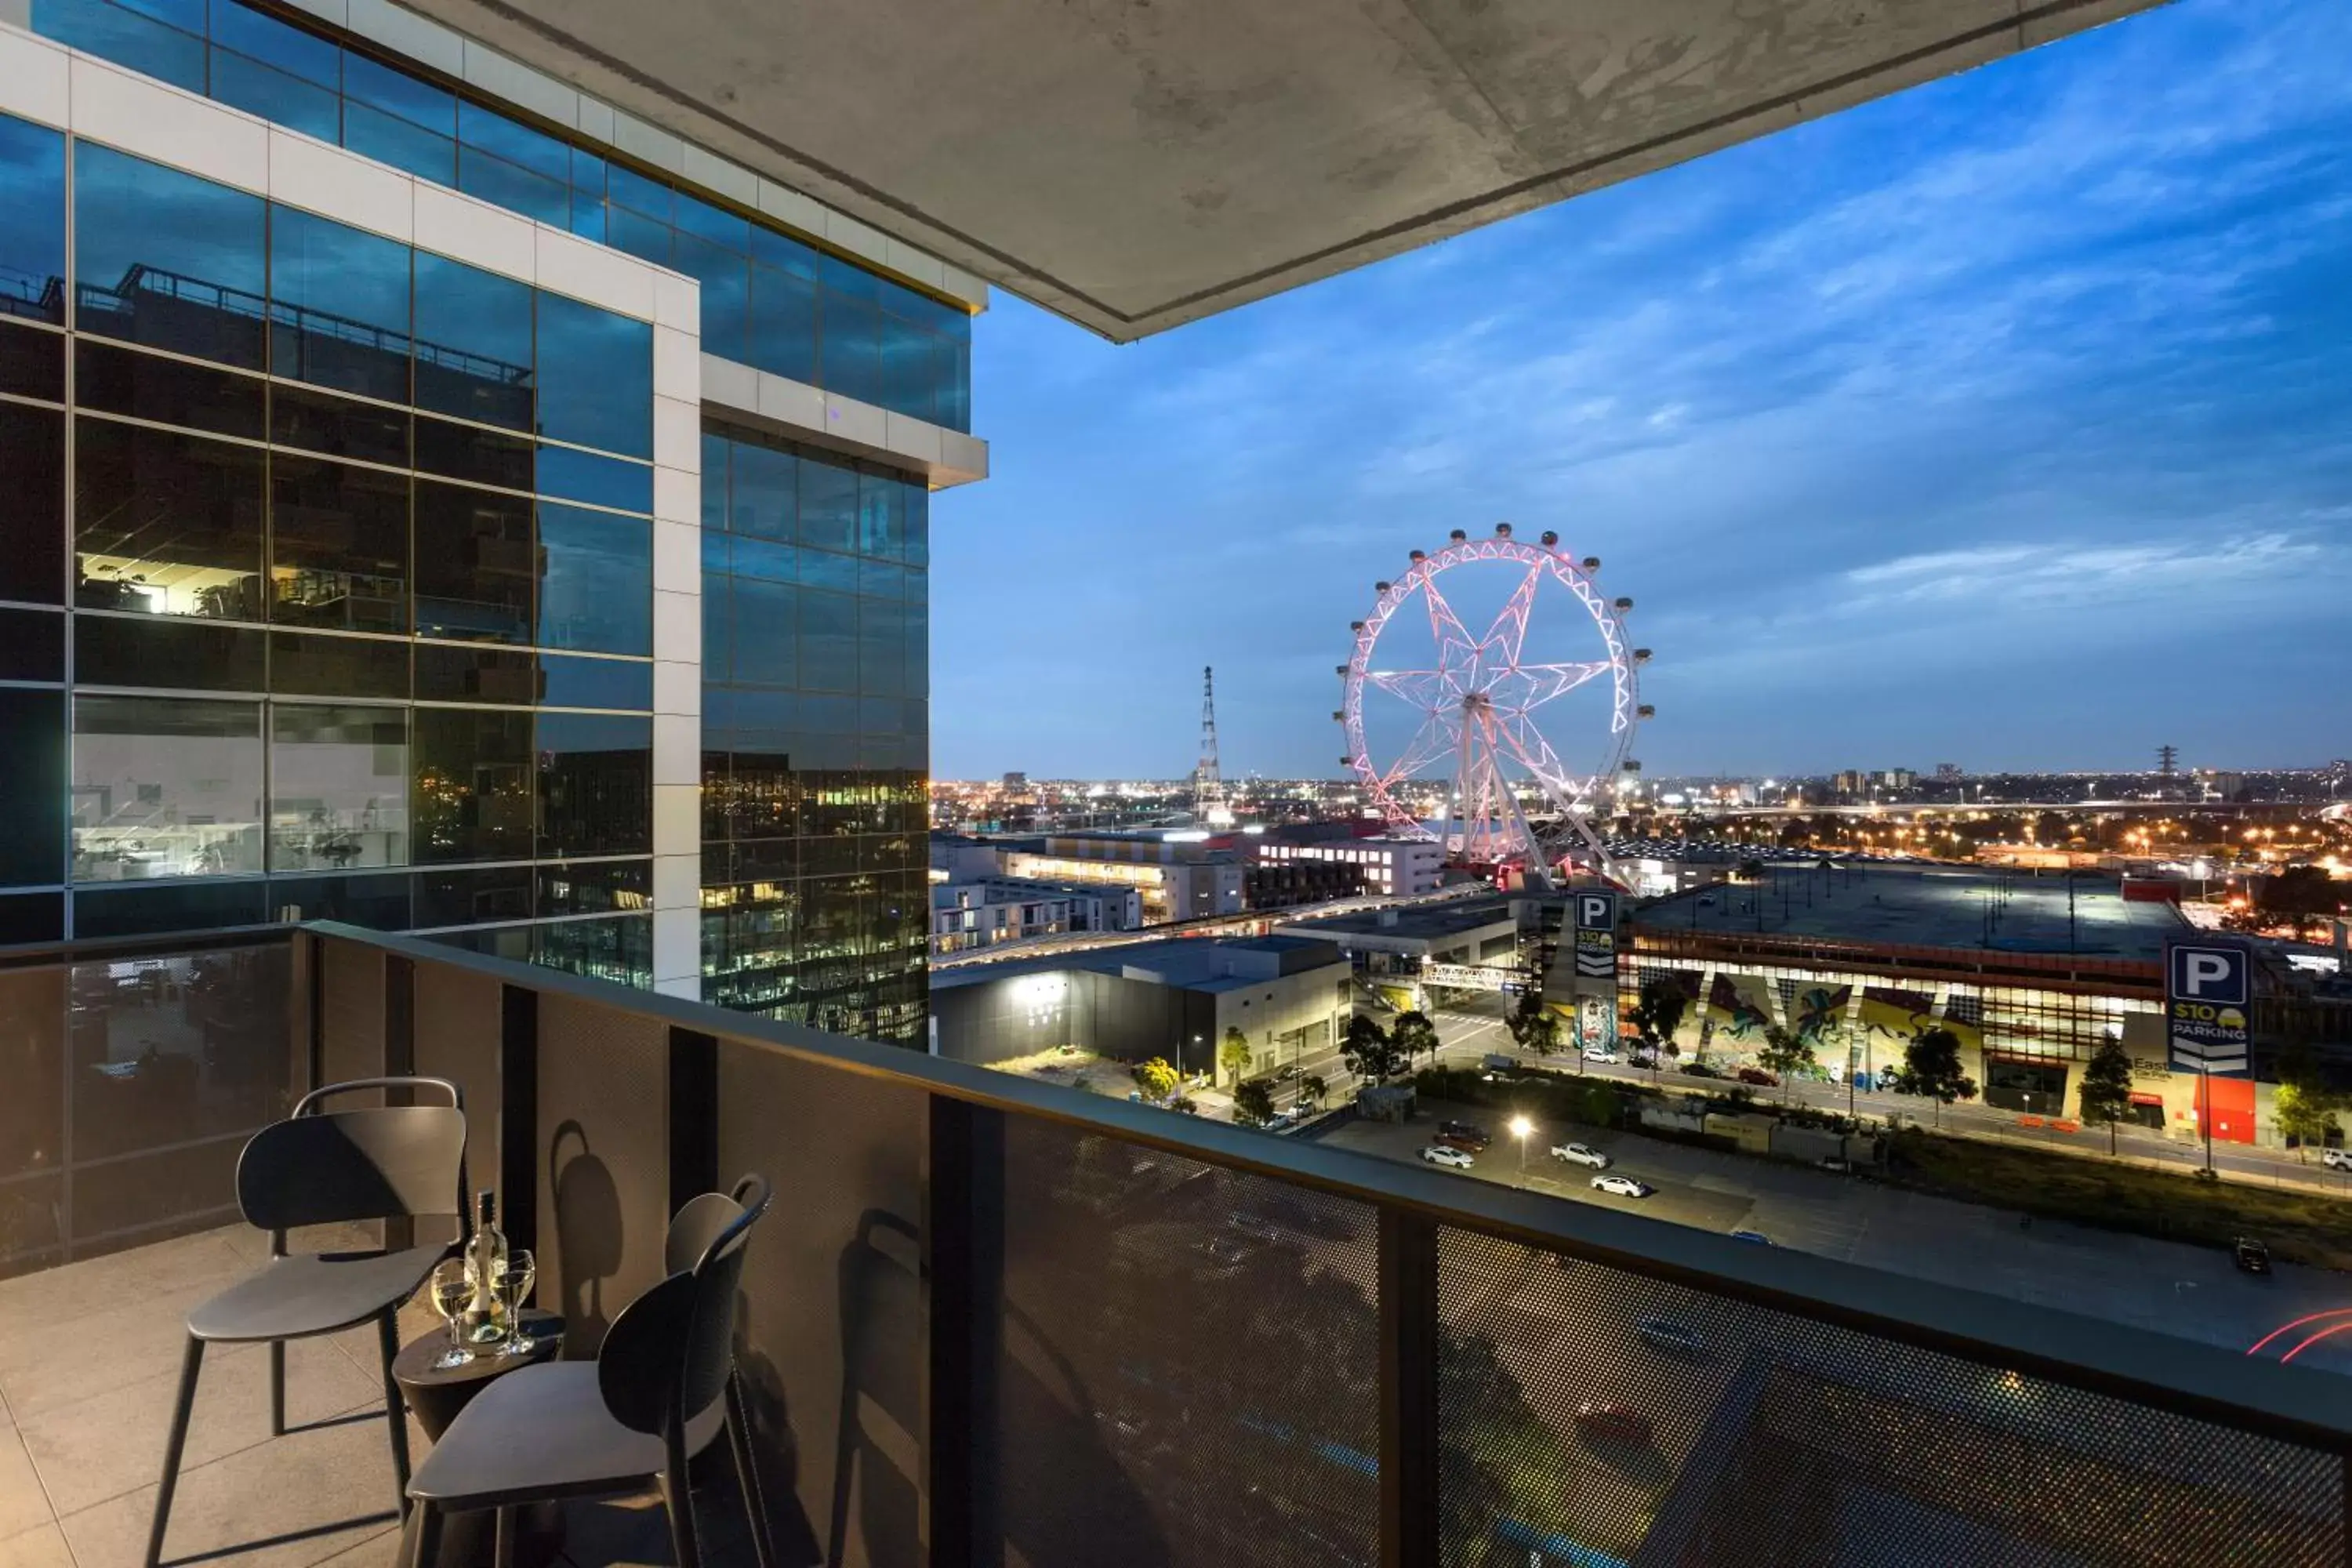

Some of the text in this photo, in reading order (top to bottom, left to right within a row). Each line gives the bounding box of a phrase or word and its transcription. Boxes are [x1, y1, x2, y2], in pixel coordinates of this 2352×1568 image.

[1584, 898, 1606, 925] P
[2187, 953, 2230, 994] P
[2174, 1003, 2216, 1021] $10
[2173, 1024, 2246, 1040] PARKING
[2134, 1058, 2168, 1072] East
